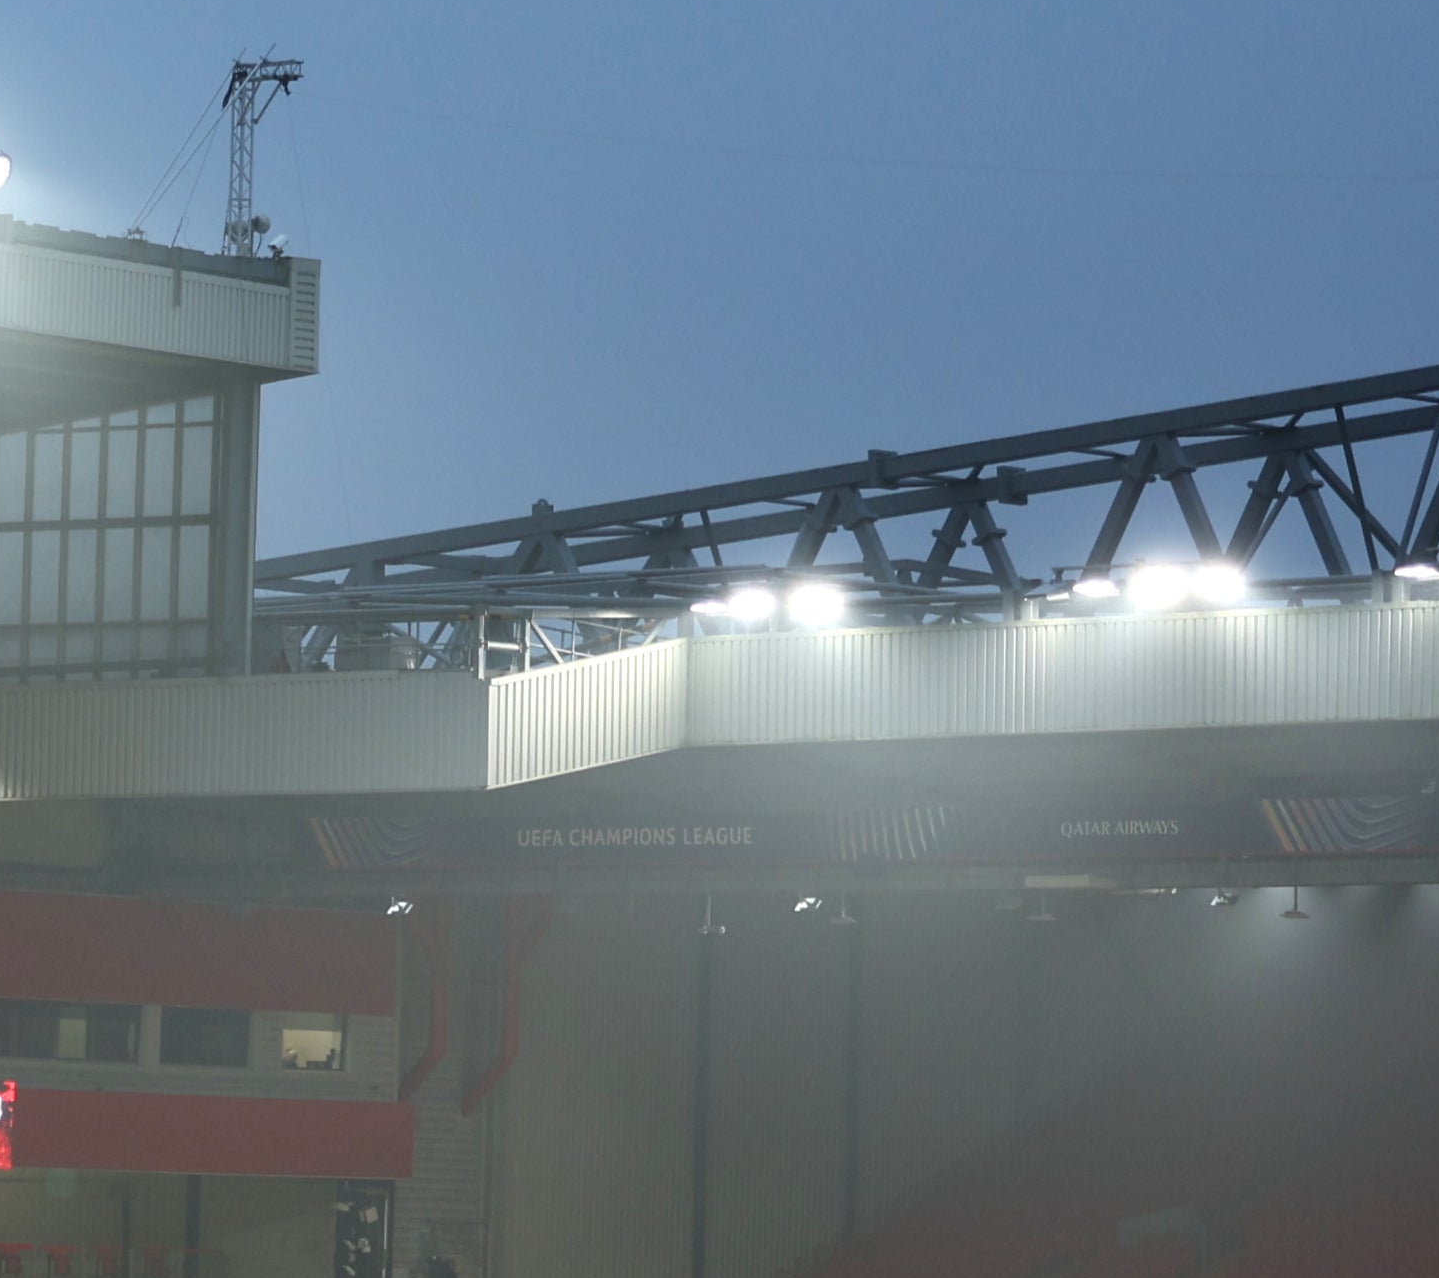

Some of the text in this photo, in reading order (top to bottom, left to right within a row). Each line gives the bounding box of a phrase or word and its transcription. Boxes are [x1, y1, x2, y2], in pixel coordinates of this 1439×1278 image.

[517, 825, 753, 848] UEFA CHAMPIONS LEAGUE
[1061, 820, 1178, 839] QATAR AIRWAYS
